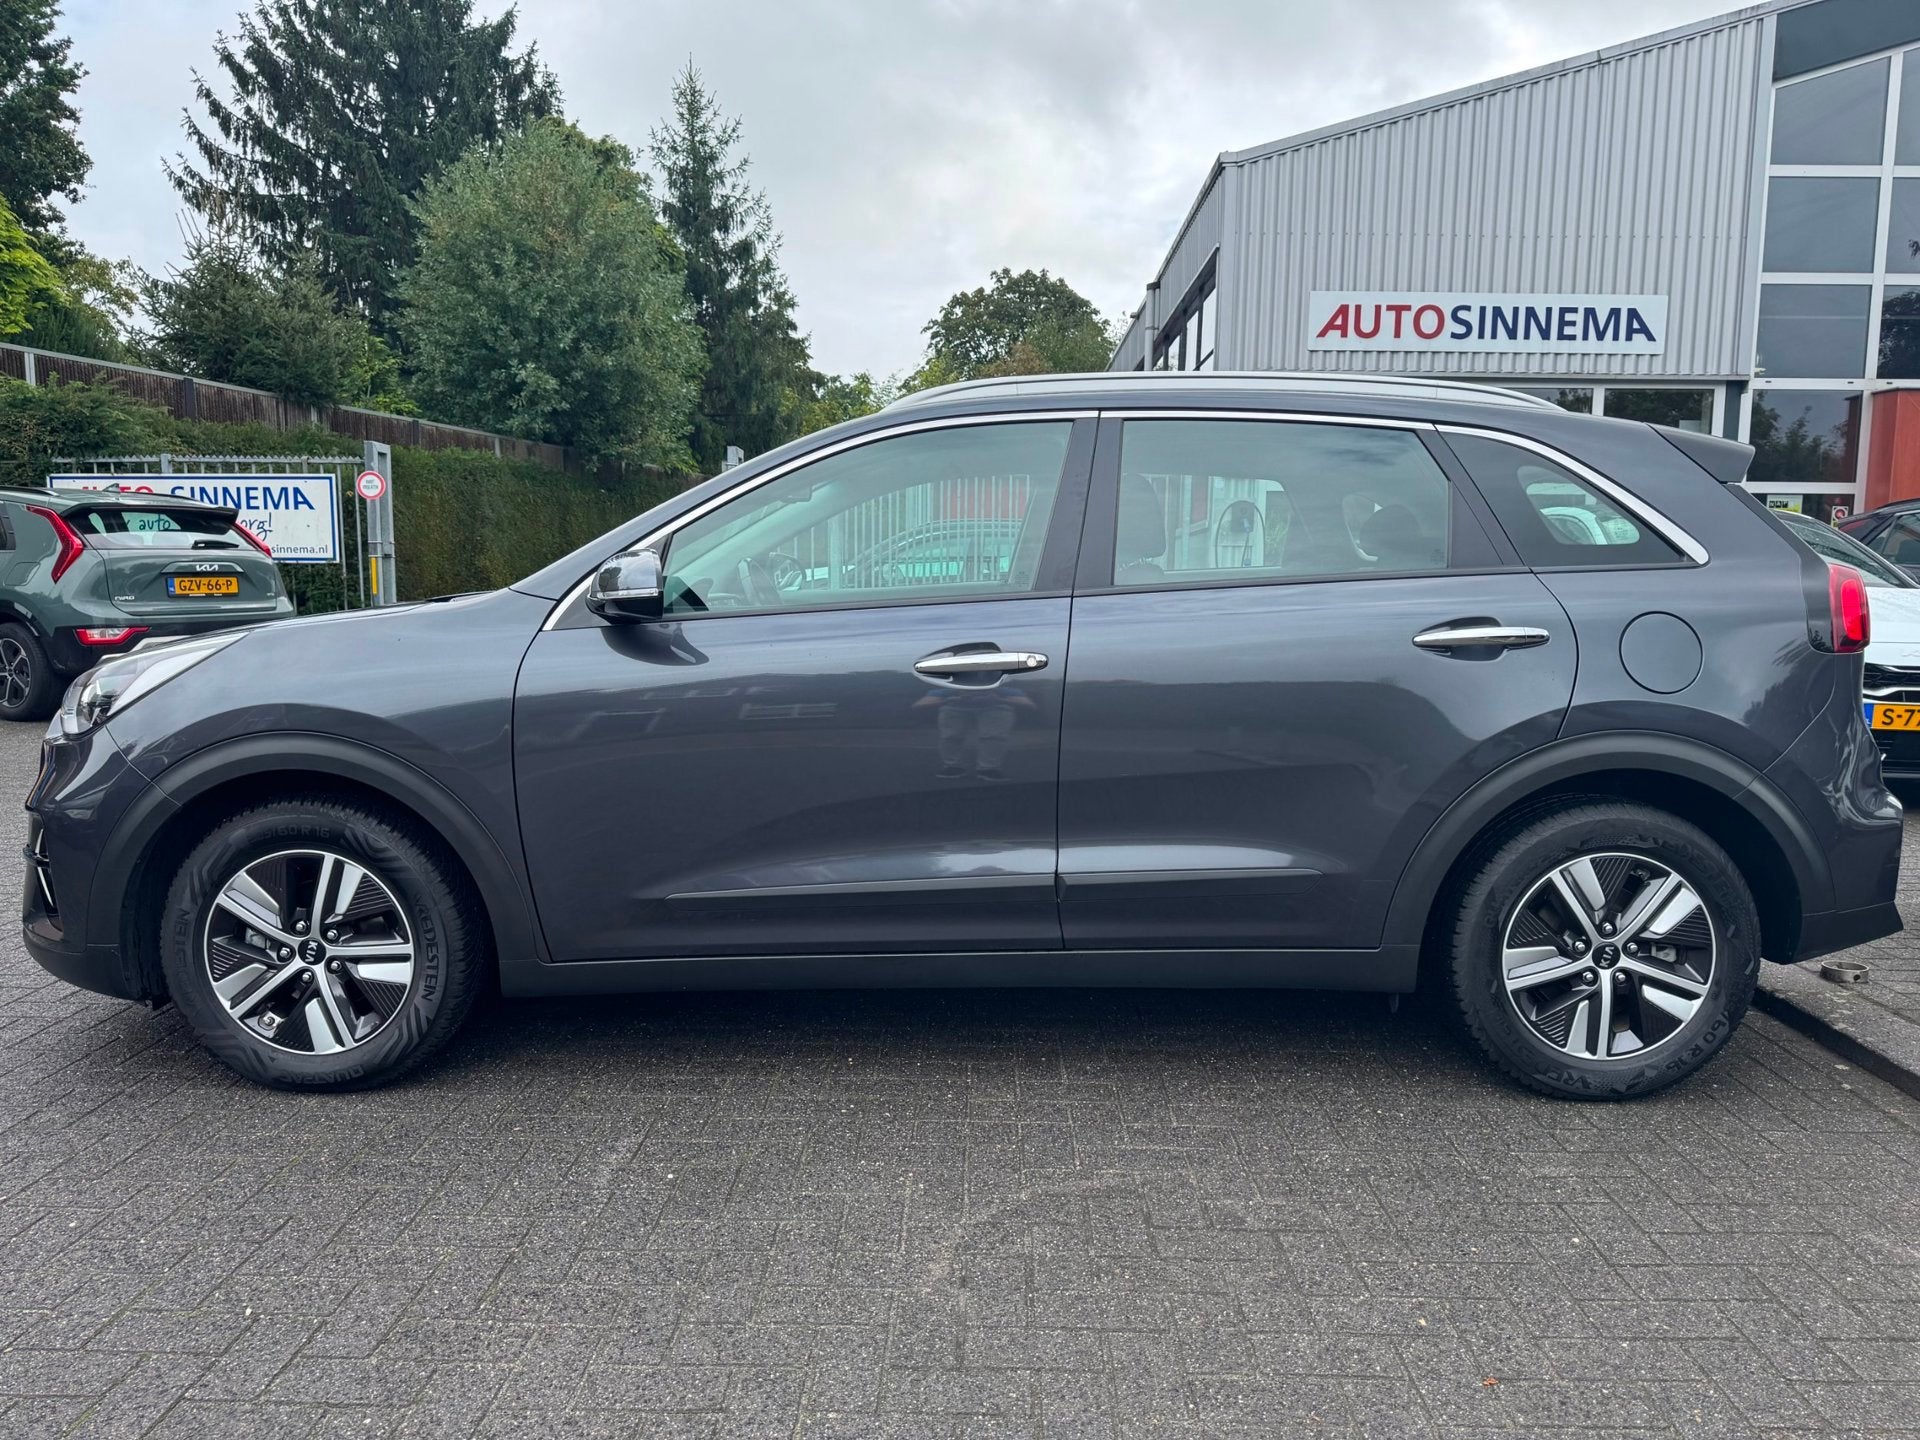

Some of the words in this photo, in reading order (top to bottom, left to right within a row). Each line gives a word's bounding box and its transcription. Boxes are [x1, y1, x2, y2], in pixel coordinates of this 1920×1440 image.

[139, 513, 171, 531] auto
[195, 564, 219, 572] KIA
[179, 579, 233, 592] GZV-66-P
[304, 940, 319, 962] KIA
[414, 896, 440, 1002] VREDESTEIN
[1599, 946, 1615, 968] KIA
[1688, 1043, 1704, 1058] R
